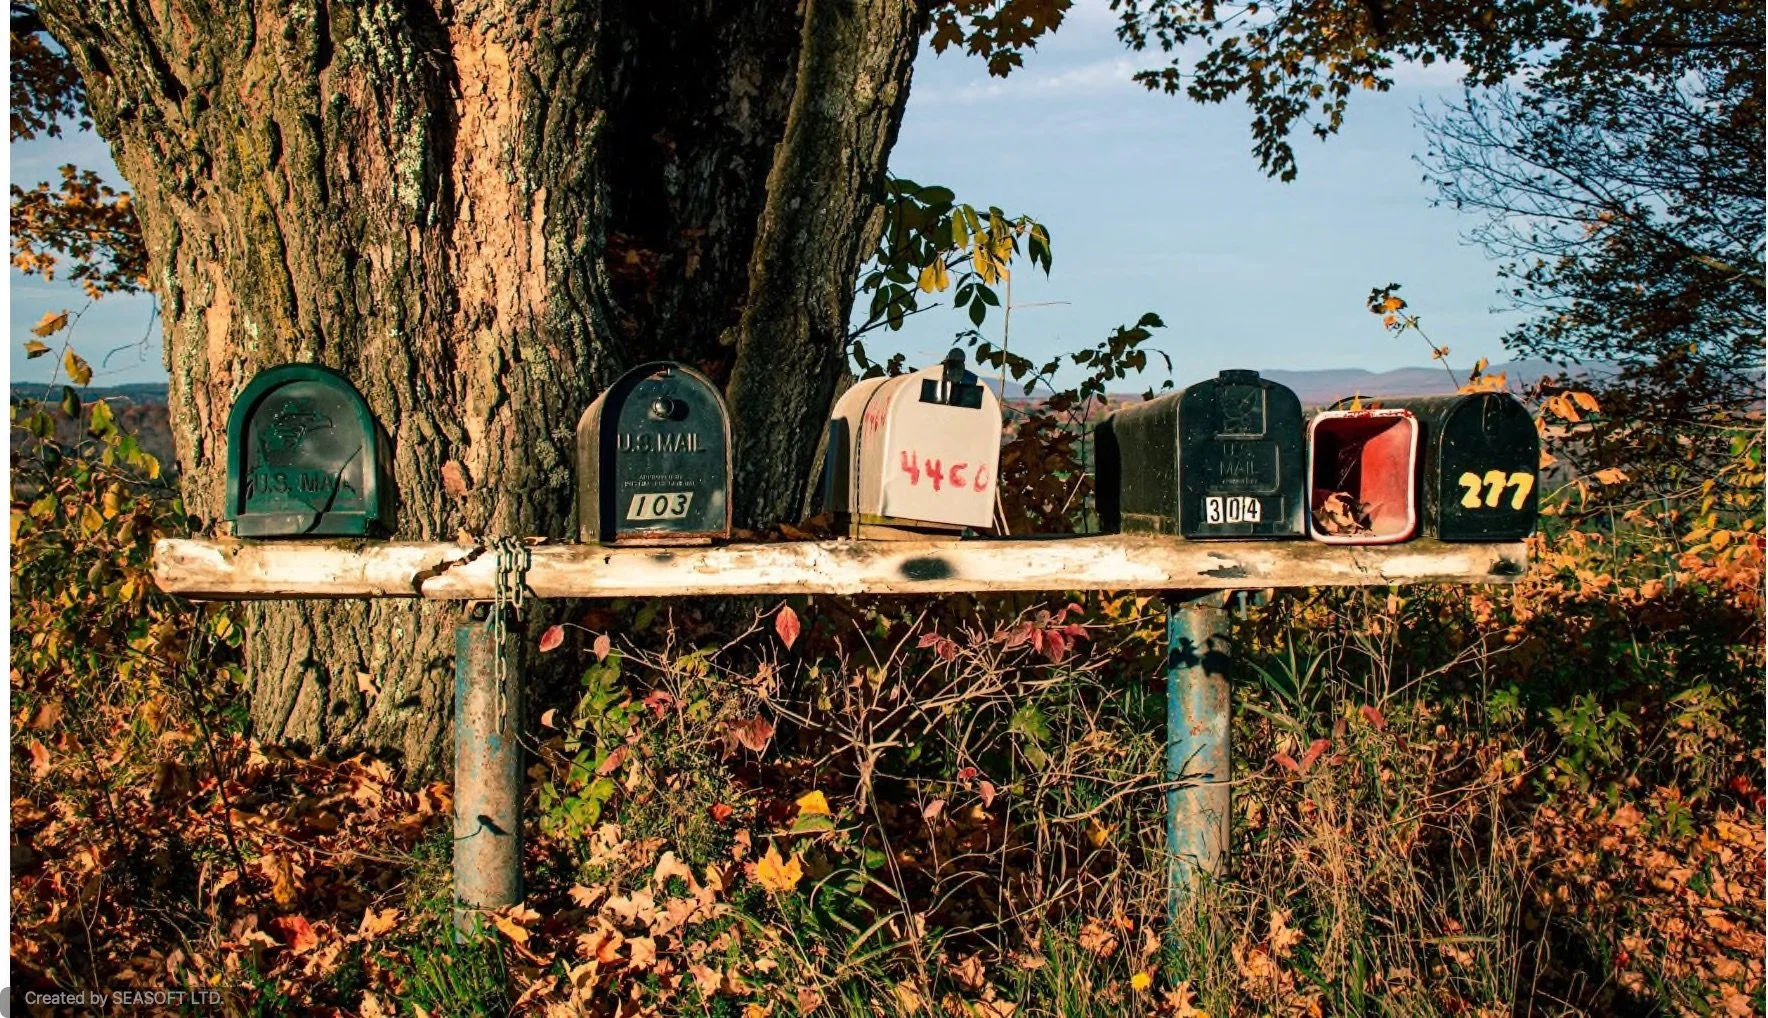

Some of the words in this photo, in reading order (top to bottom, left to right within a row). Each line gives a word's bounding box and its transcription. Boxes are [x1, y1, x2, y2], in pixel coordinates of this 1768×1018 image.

[617, 433, 654, 453] U.S.
[657, 433, 706, 453] MAIL
[1220, 460, 1256, 476] MAIL
[1458, 469, 1535, 510] 277
[636, 494, 688, 516] 103
[1209, 498, 1257, 522] 304
